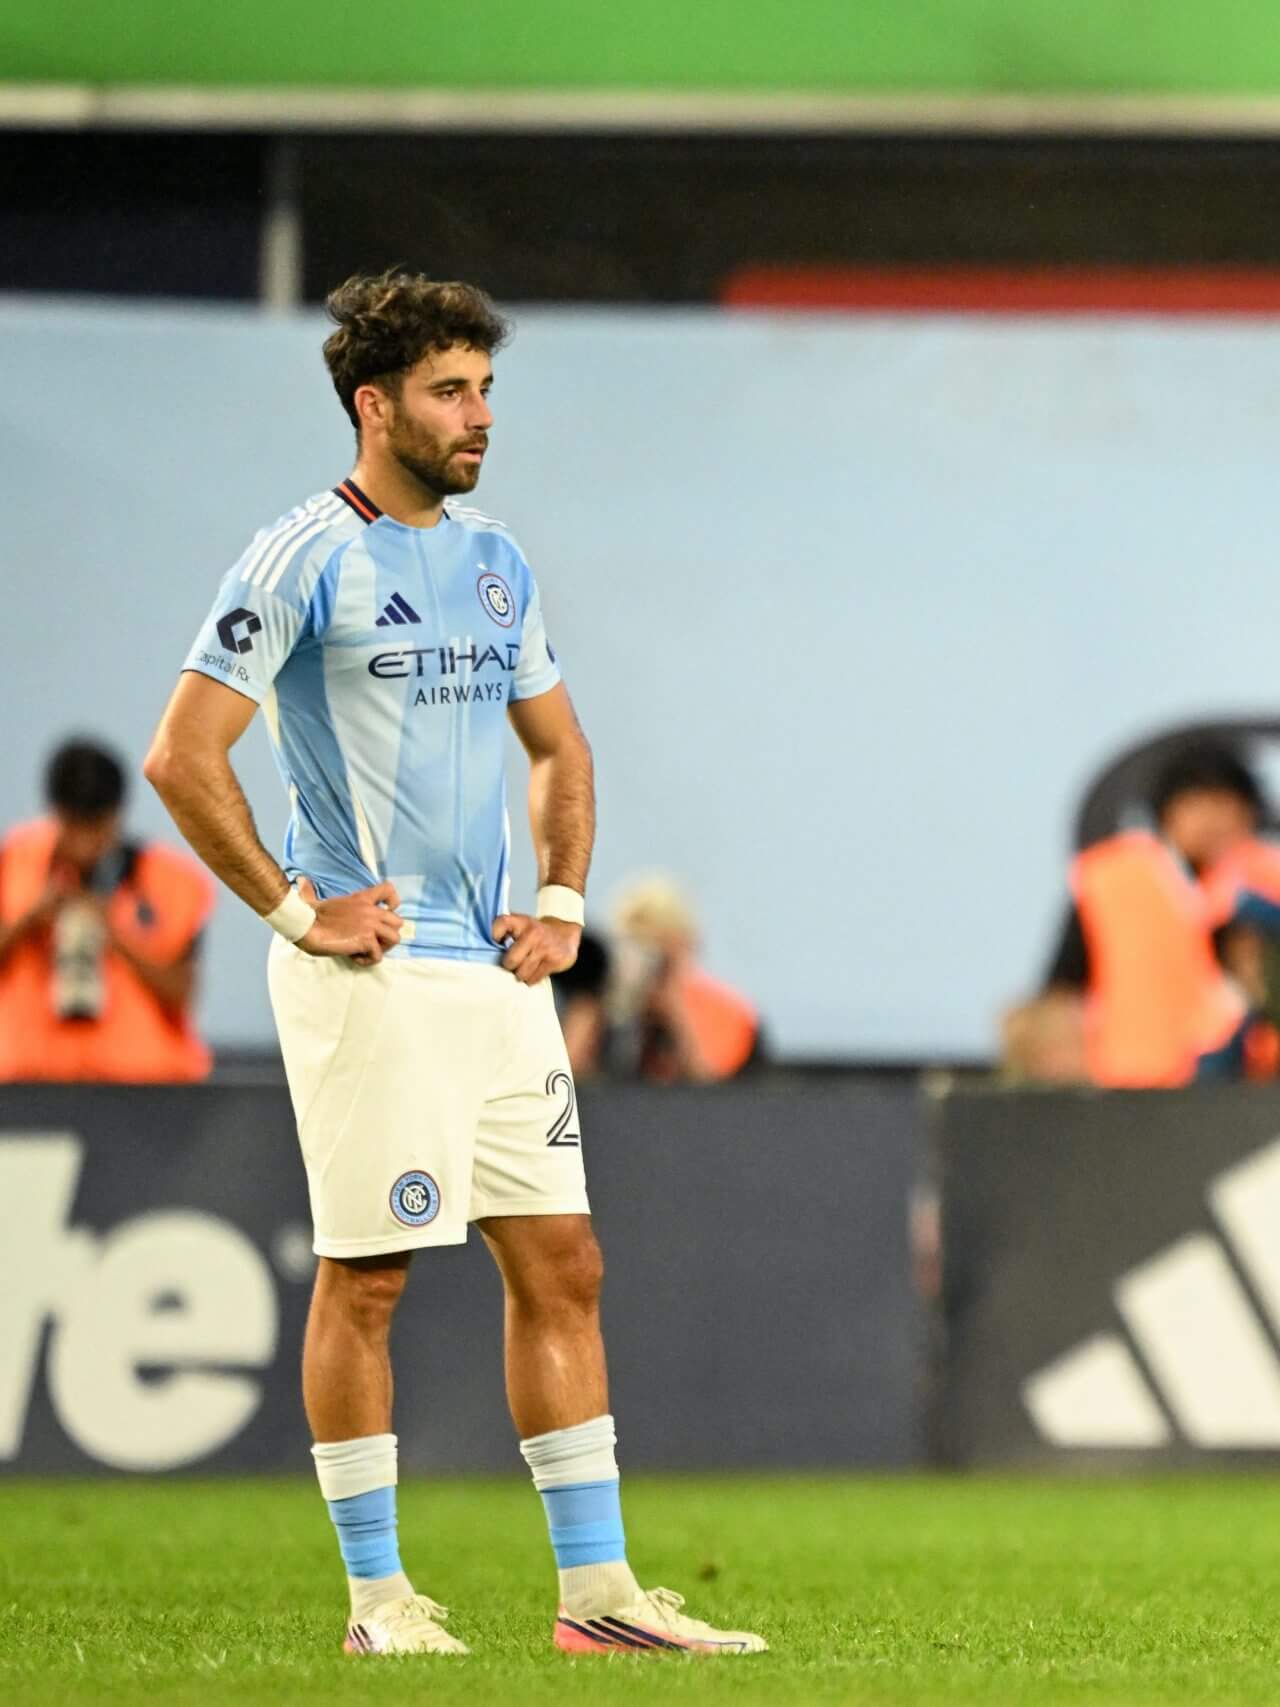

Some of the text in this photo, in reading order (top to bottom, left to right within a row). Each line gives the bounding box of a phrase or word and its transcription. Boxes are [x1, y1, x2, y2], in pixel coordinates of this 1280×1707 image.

[368, 643, 520, 679] ETIHAD
[413, 682, 504, 706] AIRWAYS
[545, 1068, 579, 1147] 2
